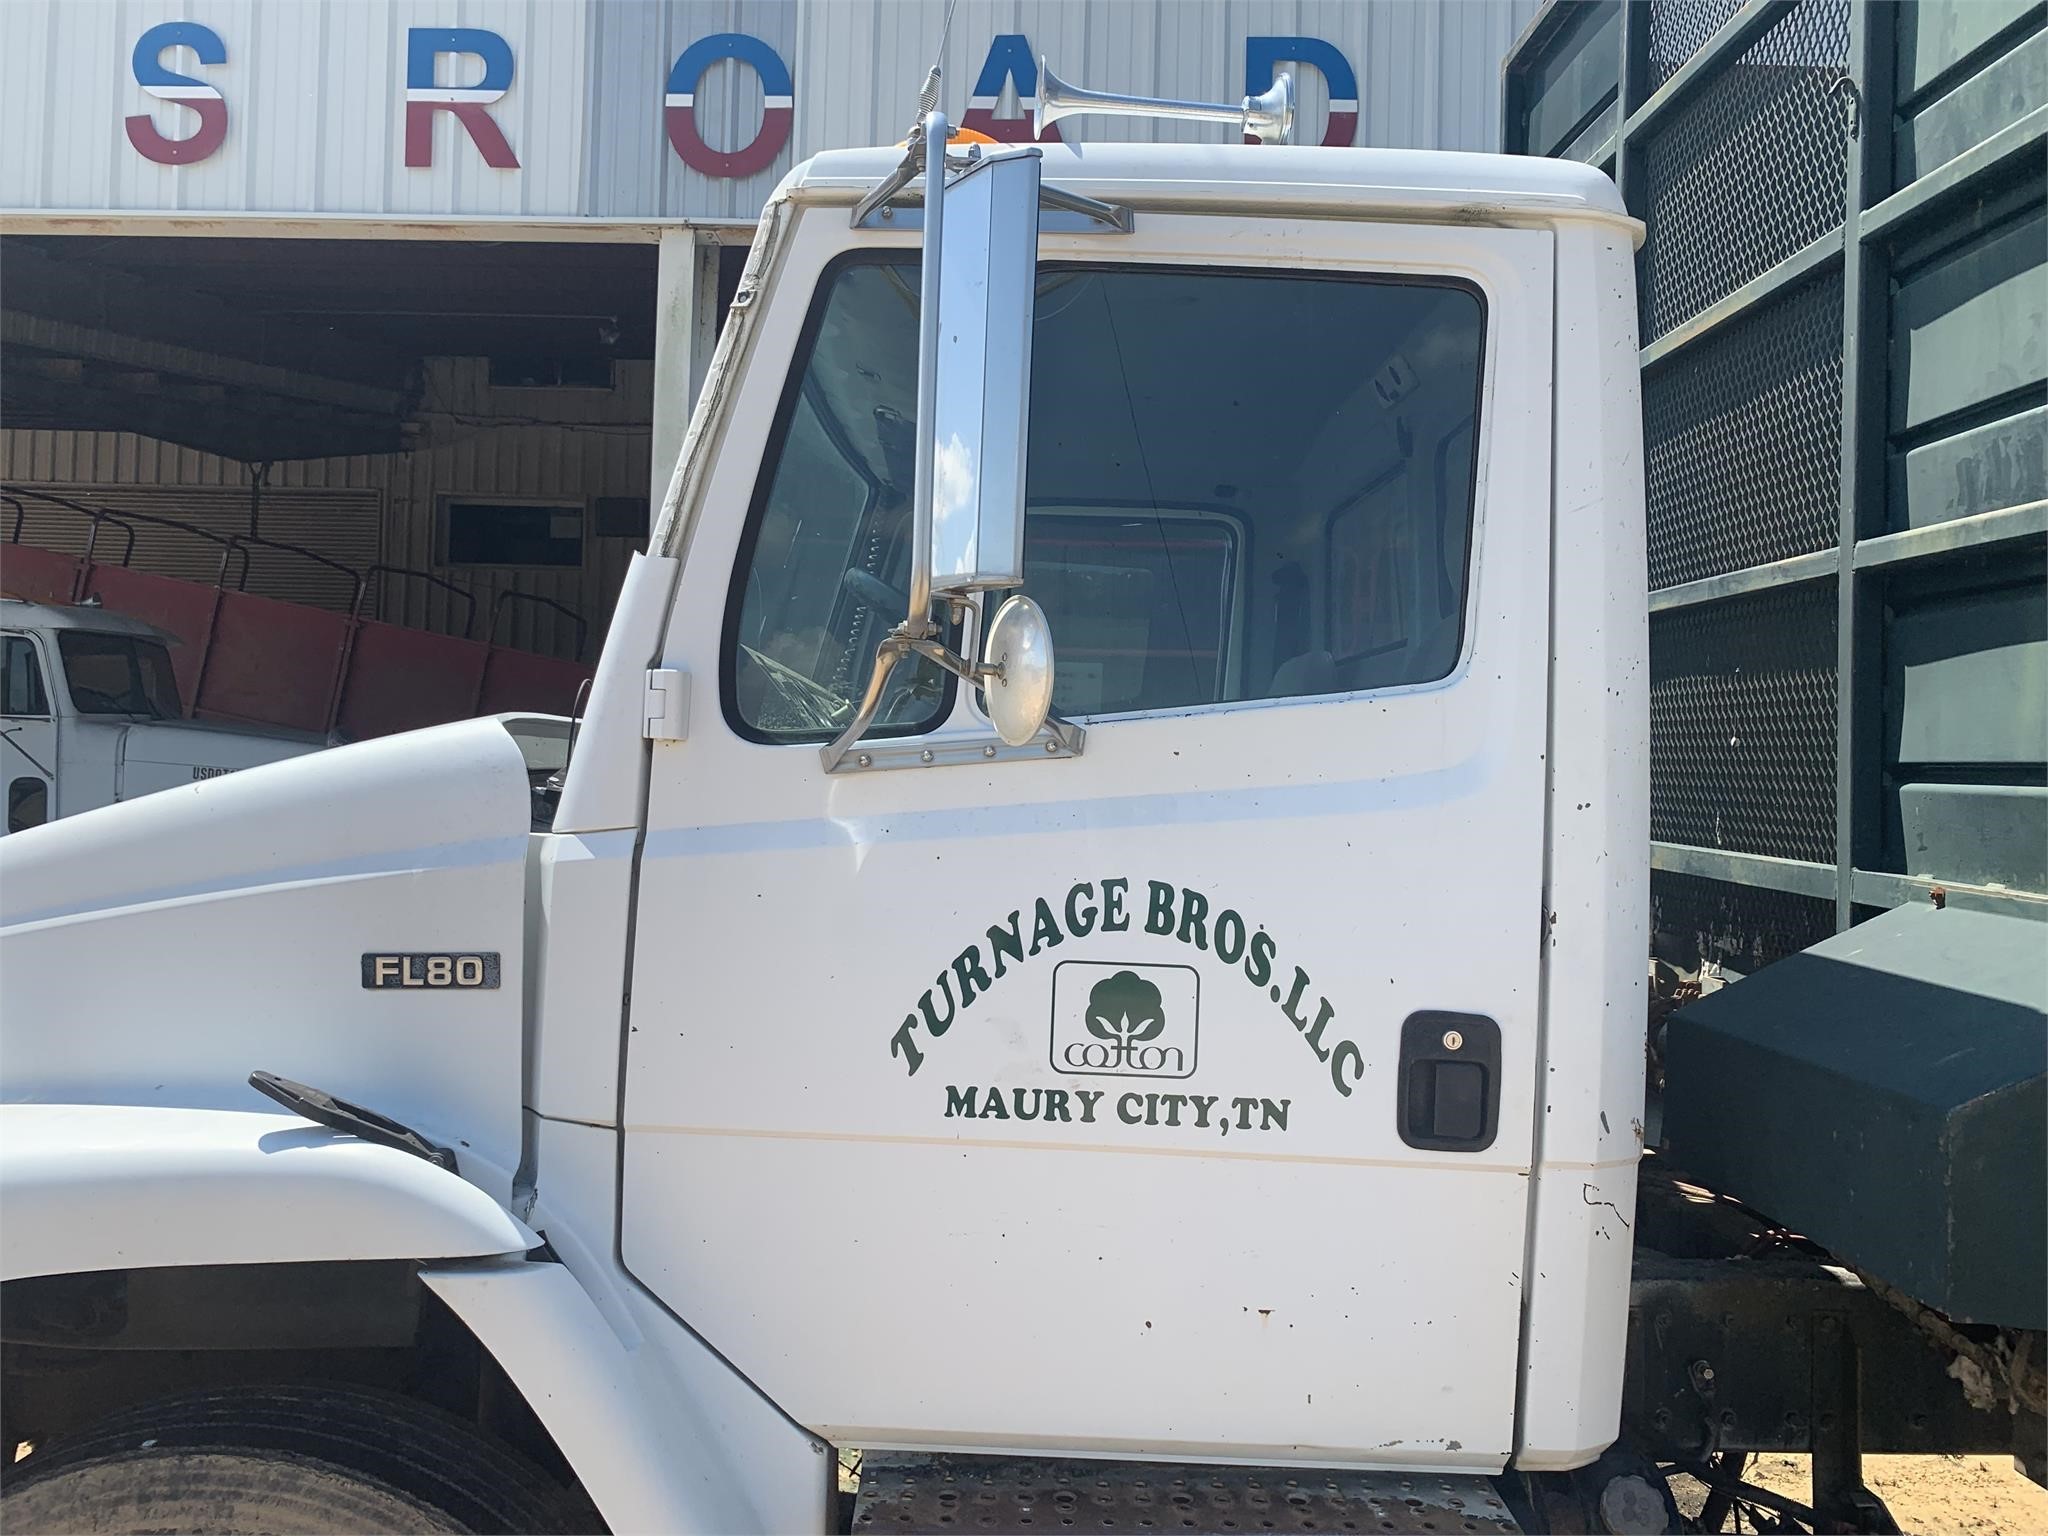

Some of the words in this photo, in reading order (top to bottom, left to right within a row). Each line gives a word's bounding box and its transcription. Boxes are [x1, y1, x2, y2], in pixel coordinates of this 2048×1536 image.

[375, 956, 483, 986] FL80
[891, 877, 1130, 1076] TURNAGE
[1064, 1042, 1184, 1071] cotton
[944, 1086, 1104, 1123] MAURY
